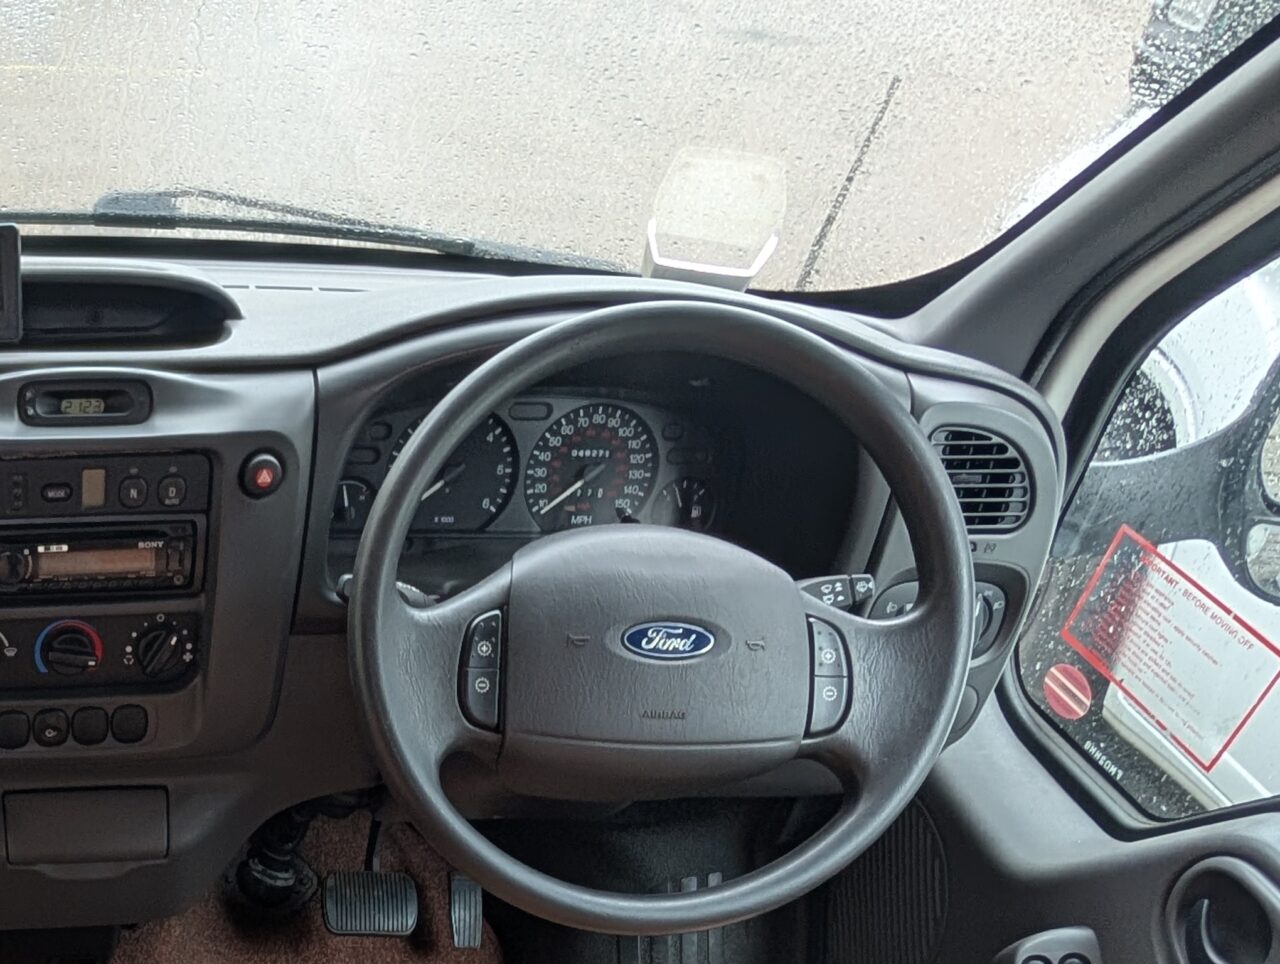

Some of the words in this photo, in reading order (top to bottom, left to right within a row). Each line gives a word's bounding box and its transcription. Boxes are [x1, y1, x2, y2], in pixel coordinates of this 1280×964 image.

[578, 418, 589, 428] 70
[593, 414, 606, 424] 80
[608, 418, 620, 428] 90
[561, 425, 574, 435] 60
[619, 427, 634, 437] 100
[486, 431, 494, 443] 4
[549, 437, 562, 447] 50
[628, 440, 641, 449] 110
[539, 452, 551, 461] 40
[630, 454, 645, 464] 120
[534, 468, 547, 477] 30
[629, 470, 644, 480] 130
[535, 483, 547, 494] 20
[624, 485, 639, 495] 140
[482, 498, 490, 509] 6
[615, 499, 630, 508] 150
[571, 515, 592, 524] MPH
[138, 541, 164, 549] SONY
[1180, 588, 1210, 614] BEFORE
[1208, 611, 1239, 639] MOVING
[641, 627, 696, 652] Ford
